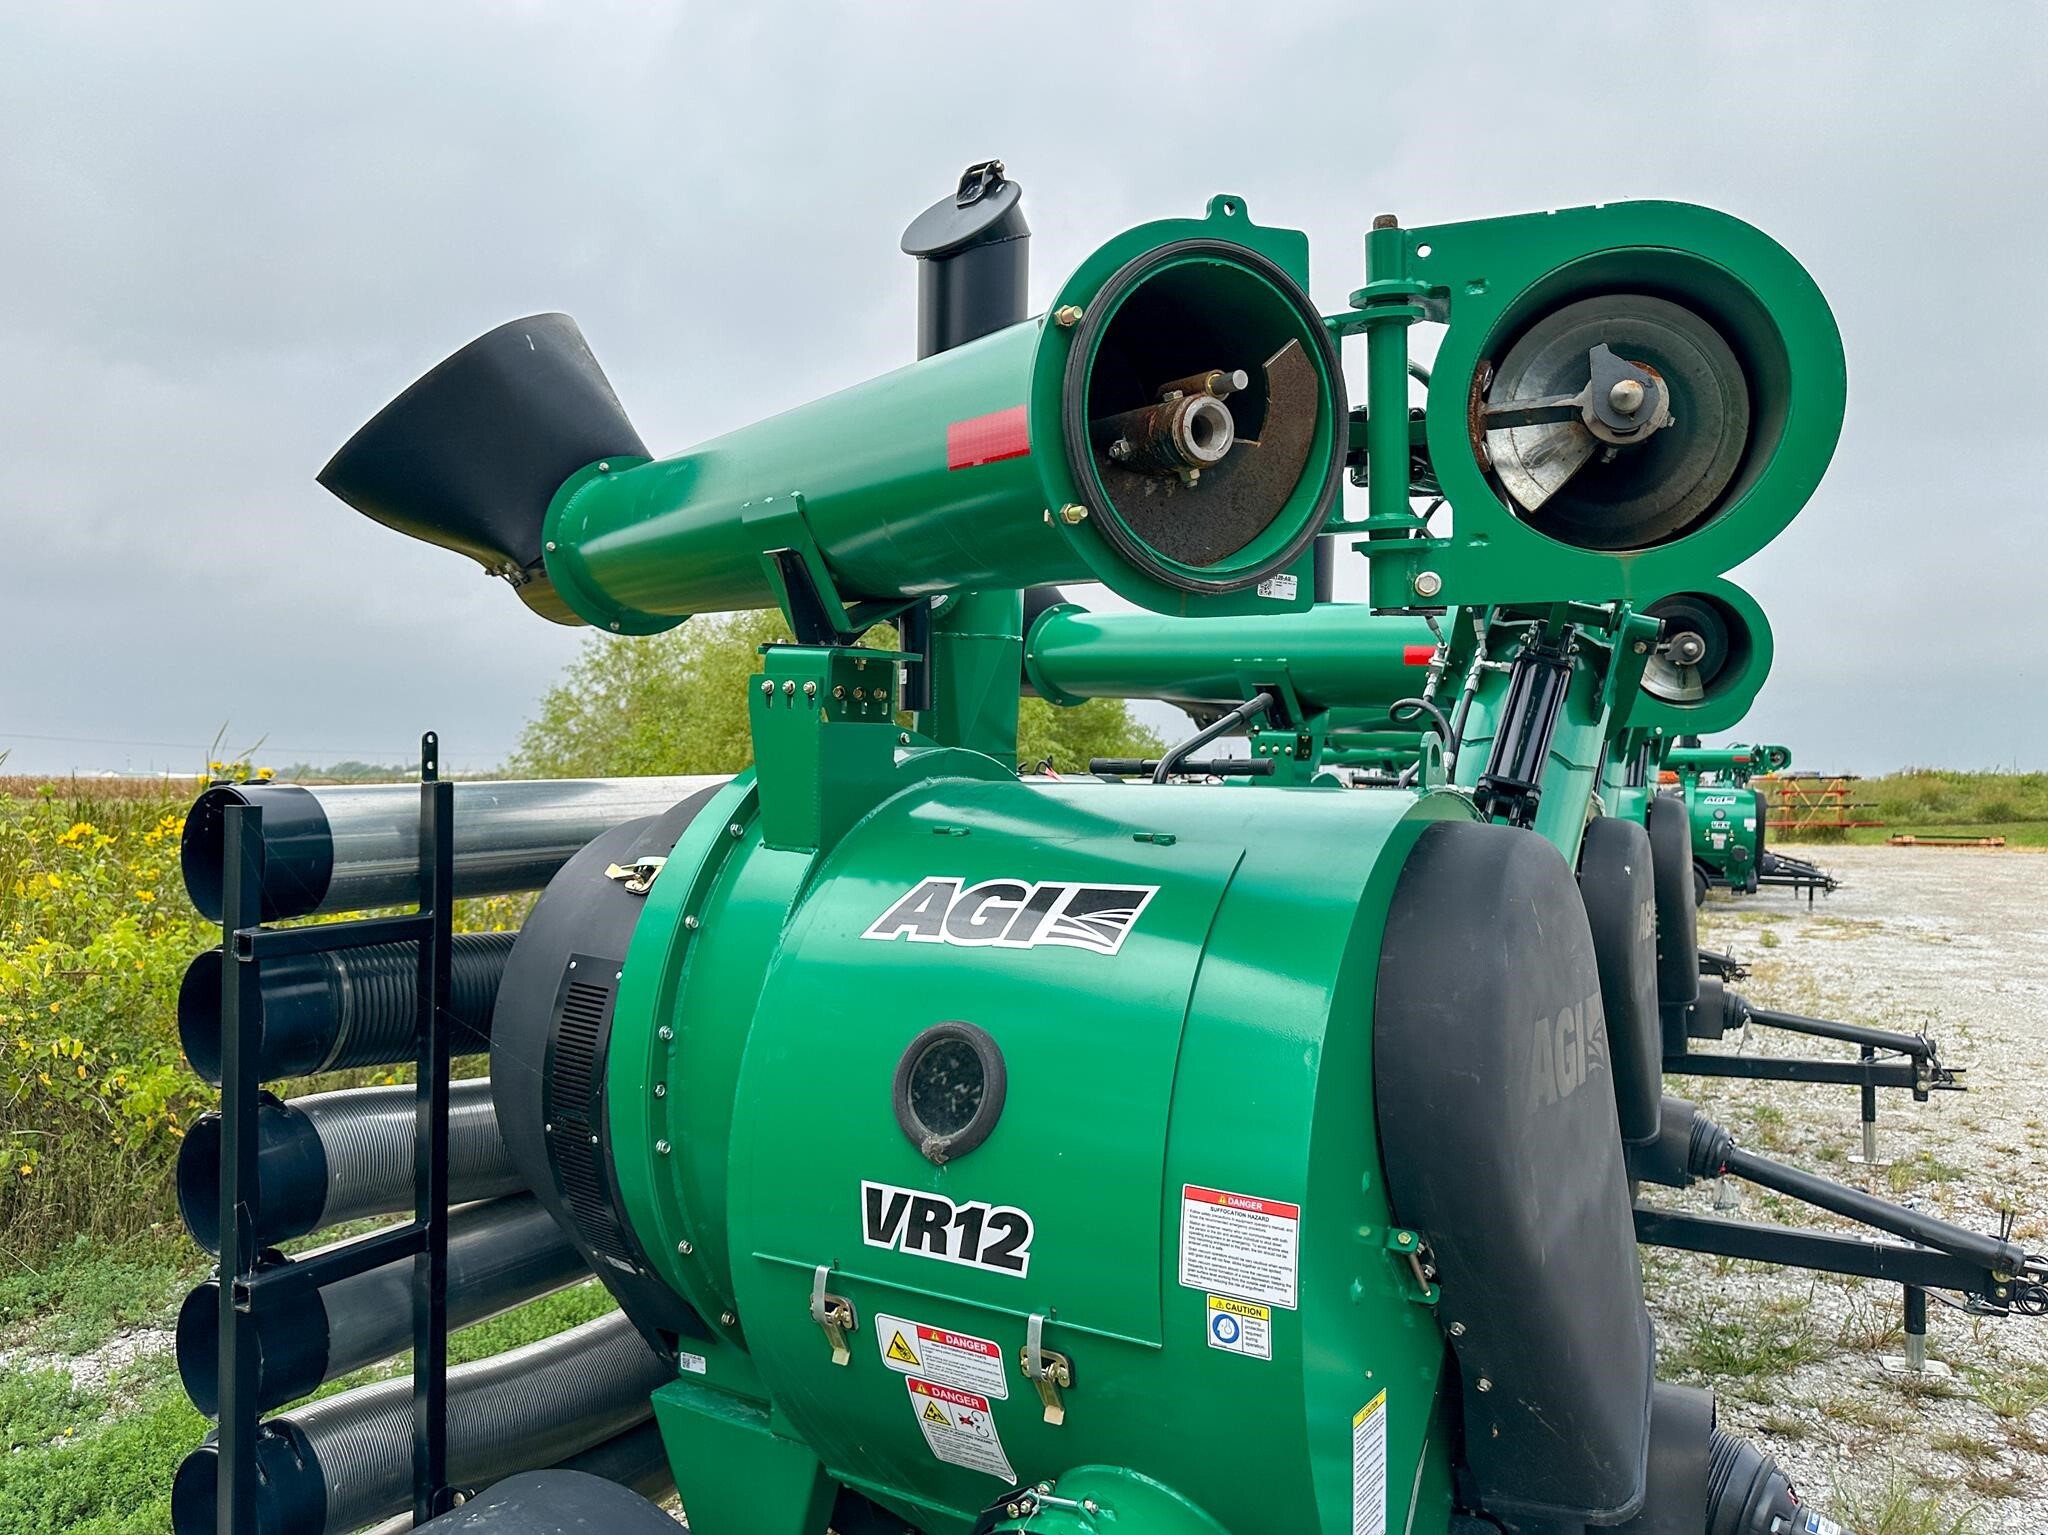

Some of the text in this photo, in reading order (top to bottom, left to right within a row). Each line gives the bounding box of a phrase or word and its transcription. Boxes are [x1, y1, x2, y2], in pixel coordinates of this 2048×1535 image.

[872, 881, 1067, 943] AGI
[1528, 1001, 1587, 1107] AGI
[1227, 1195, 1263, 1211] DANGER
[1210, 1206, 1247, 1218] SUFFOCATION
[1247, 1213, 1270, 1222] HAZARD
[865, 1186, 1029, 1272] VR12
[1225, 1302, 1262, 1317] CAUTION
[945, 1335, 988, 1353] DANGER
[931, 1387, 980, 1408] DANGER
